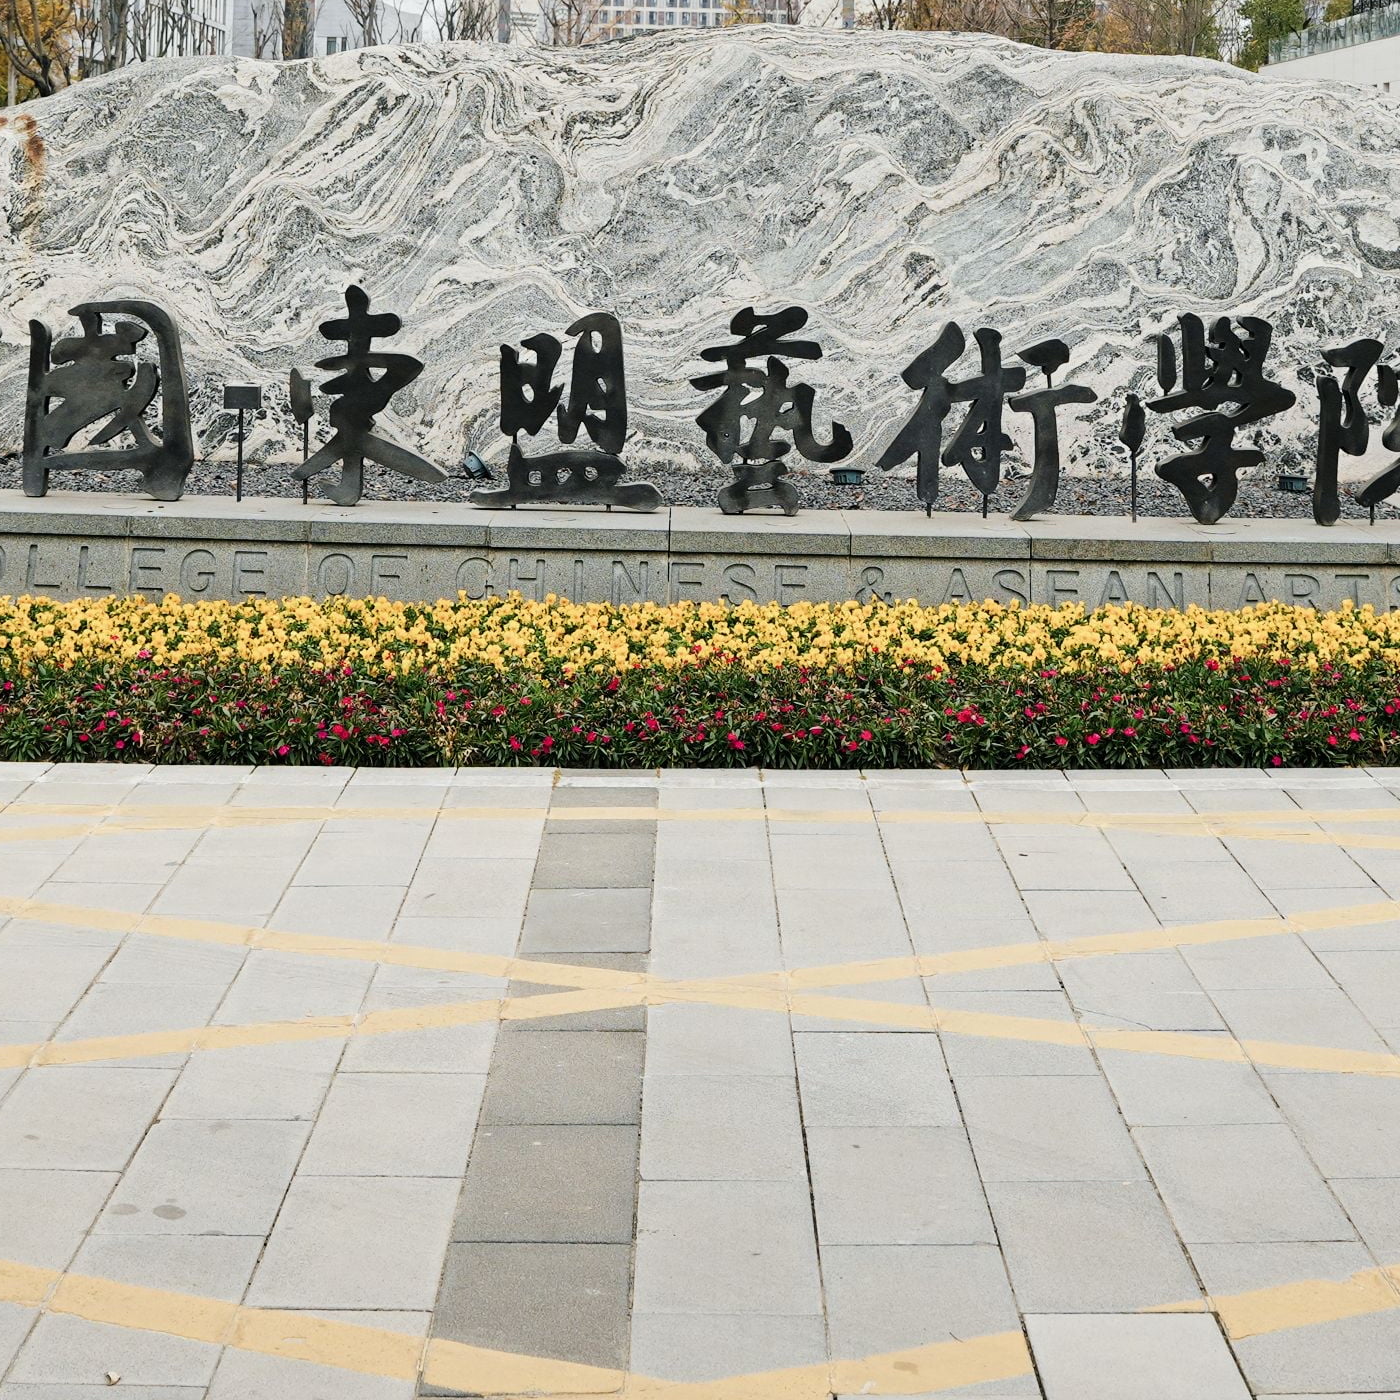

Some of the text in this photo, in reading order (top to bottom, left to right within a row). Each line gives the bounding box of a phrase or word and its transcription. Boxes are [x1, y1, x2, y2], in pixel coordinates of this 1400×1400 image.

[317, 553, 408, 598] OF
[455, 557, 808, 606] CHINESE
[854, 566, 893, 607] &
[942, 568, 1184, 613] ASEAN
